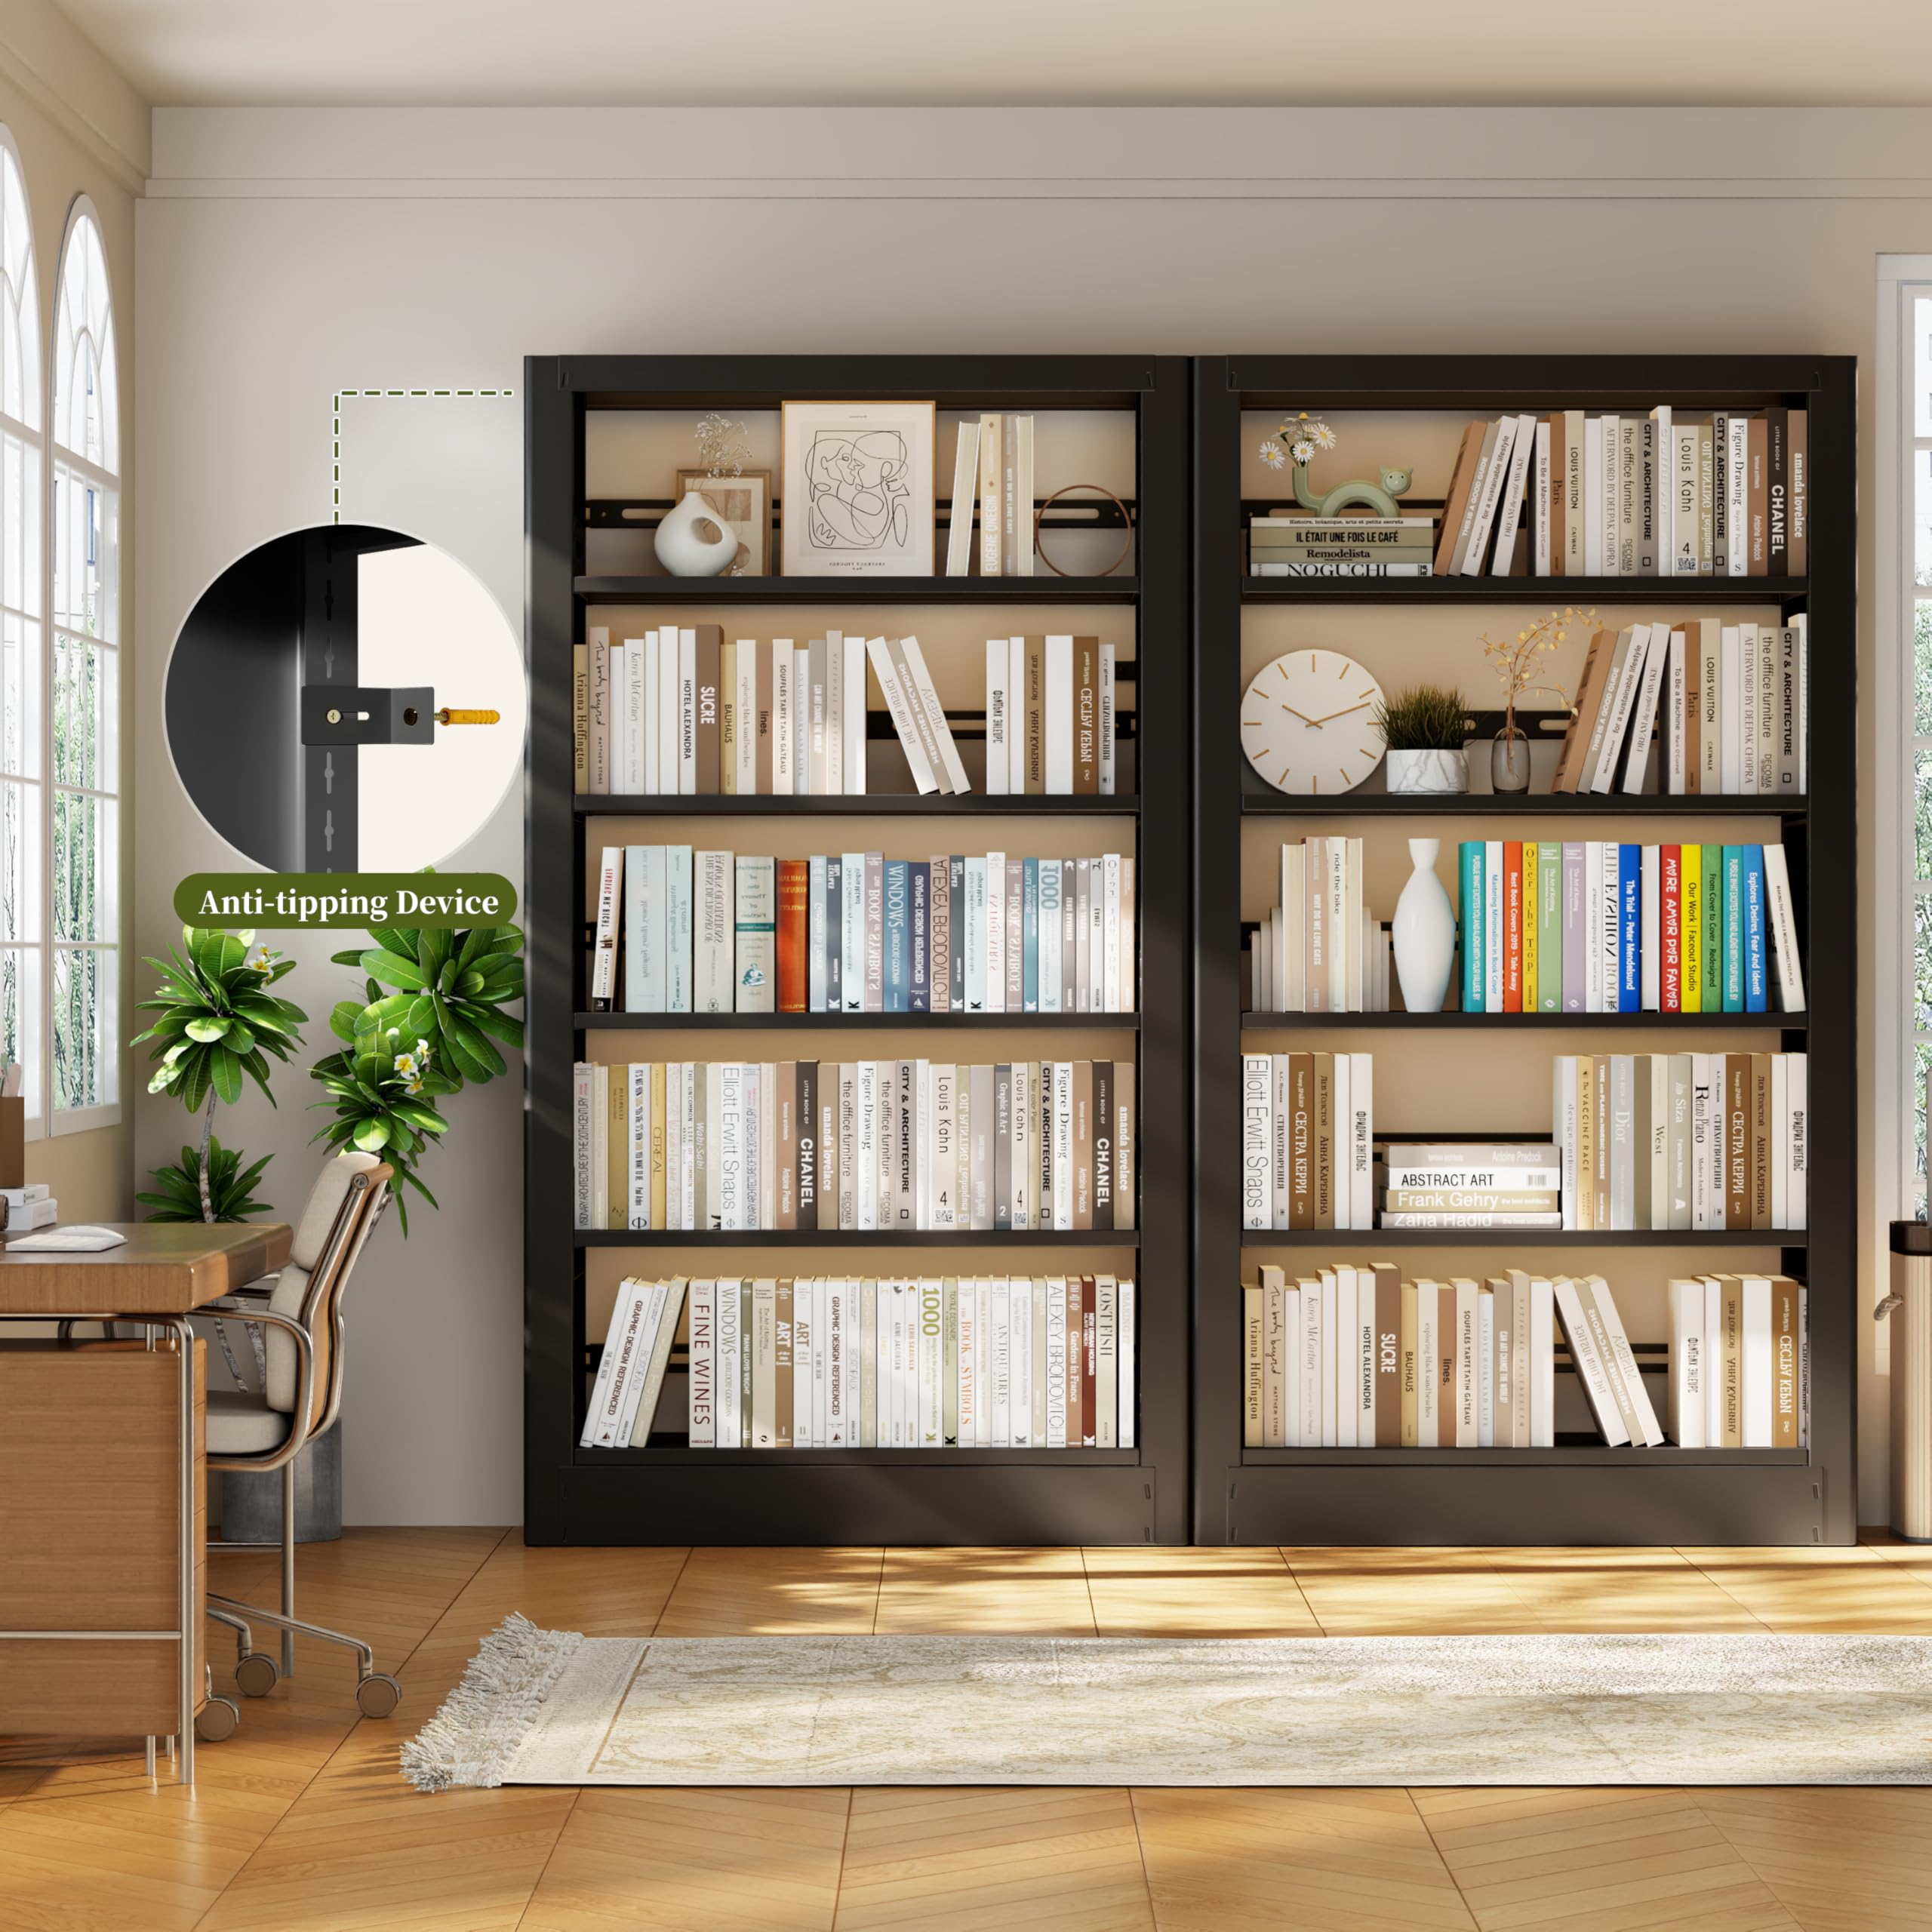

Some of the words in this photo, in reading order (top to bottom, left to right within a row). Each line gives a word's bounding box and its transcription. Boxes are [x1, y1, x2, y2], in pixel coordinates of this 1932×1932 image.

[1623, 428, 1634, 444] the
[1732, 425, 1744, 458] Figure
[1540, 457, 1546, 466] To
[1681, 438, 1694, 472] Louis
[1540, 467, 1546, 478] Be
[1732, 461, 1744, 506] Drawing
[1794, 453, 1804, 493] amanda
[1552, 479, 1562, 505] Paris
[1623, 481, 1634, 524] furniture
[1681, 481, 1694, 512] Kahn
[985, 495, 997, 531] ONEGIN
[1772, 485, 1784, 555] CHANEL
[1794, 496, 1804, 537] lovelace
[1297, 532, 1303, 543] IL
[1306, 528, 1327, 543] ÉTAIT
[1329, 532, 1344, 543] UNE
[1347, 532, 1364, 543] FOIS
[1367, 532, 1376, 543] LE
[1378, 528, 1398, 543] CAFÉ
[1683, 543, 1690, 554] 4
[985, 534, 997, 572] EUGENE
[1306, 549, 1371, 558] Remodelista
[1287, 565, 1388, 577] NOGUCHI
[577, 672, 586, 710] Arianna
[700, 687, 715, 724] SUCRE
[760, 711, 768, 737] lines.
[576, 715, 586, 769] Huffington
[888, 865, 904, 928] WINDOWS
[1626, 880, 1635, 894] The
[1688, 882, 1697, 898] Our
[1748, 872, 1758, 903] Explores
[1626, 896, 1635, 912] Trial
[1688, 900, 1697, 922] Work
[1750, 906, 1759, 934] Desires,
[1626, 921, 1635, 941] Peter
[1688, 931, 1697, 961] Faceout
[1626, 943, 1635, 989] Mendelsund
[1688, 964, 1697, 991] Studio
[1708, 949, 1716, 987] Redesigned
[1752, 971, 1761, 995] Identit
[939, 1077, 951, 1111] Louis
[998, 1083, 1008, 1110] Graphic
[1247, 1060, 1268, 1101] Elliott
[1695, 1084, 1709, 1116] Renzo
[939, 1119, 951, 1153] Kahn
[1119, 1106, 1130, 1146] amanda
[1247, 1107, 1268, 1150] Erwitt
[1295, 1112, 1306, 1155] СЕСТРА
[1355, 1111, 1366, 1141] ФРИДРИХ
[1655, 1126, 1665, 1155] West
[1695, 1118, 1709, 1143] Piano
[1097, 1138, 1109, 1208] CHANEL
[1119, 1150, 1130, 1191] lovelace
[1355, 1144, 1366, 1171] ЭНГЕЛЬС
[1244, 1156, 1268, 1208] Snaps
[1295, 1158, 1306, 1194] КЕРРИ
[1401, 1174, 1466, 1186] ABSTRACT
[1470, 1174, 1494, 1186] ART
[940, 1192, 947, 1205] 4
[1000, 1205, 1006, 1217] 2
[1398, 1192, 1444, 1207] Frank
[1449, 1192, 1499, 1210] Gehry
[1395, 1214, 1437, 1226] Zaha
[1444, 1214, 1492, 1226] Hadid
[922, 1287, 940, 1336] 1000
[1049, 1286, 1063, 1340] ALEXEY
[1100, 1284, 1112, 1321] LOST
[694, 1305, 709, 1349] FINE
[721, 1287, 735, 1354] WINDOWS
[777, 1321, 790, 1347] ART
[797, 1321, 809, 1346] ART
[1100, 1325, 1112, 1355] FISH
[1251, 1317, 1260, 1358] Arianna
[1381, 1334, 1395, 1373] SUCRE
[694, 1358, 709, 1425] WINES
[1049, 1346, 1063, 1436] BRODOVITCH
[1248, 1363, 1261, 1419] Huffington
